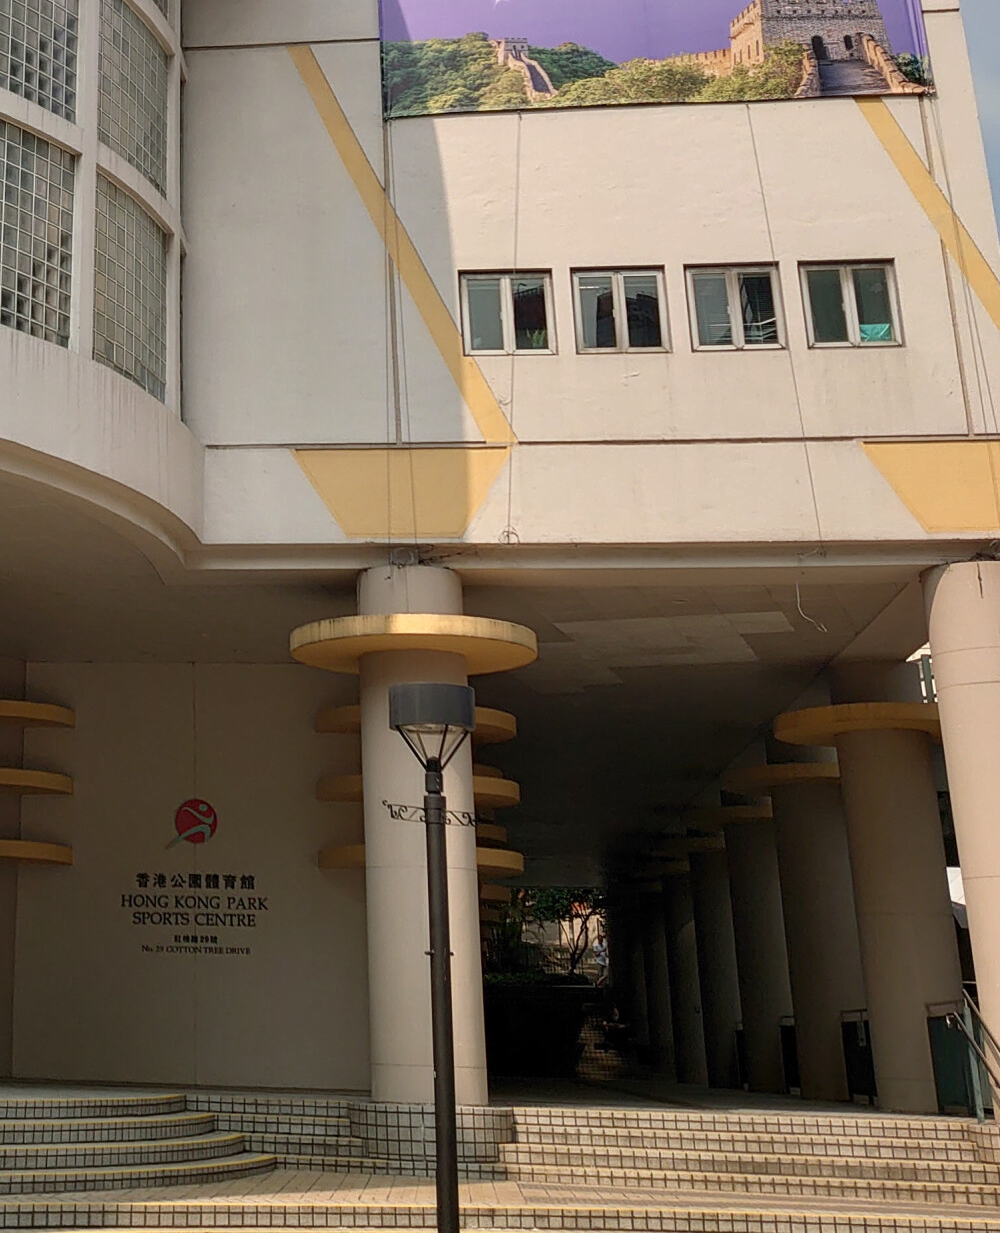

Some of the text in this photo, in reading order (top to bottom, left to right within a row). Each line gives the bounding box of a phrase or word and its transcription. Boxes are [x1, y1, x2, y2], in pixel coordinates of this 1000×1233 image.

[135, 872, 256, 890] 香港公園體育館
[121, 894, 269, 911] HONG KONG PARK
[132, 911, 257, 928] SPORTS CENTRE
[204, 946, 224, 955] TREE
[225, 946, 250, 955] DRIVE
